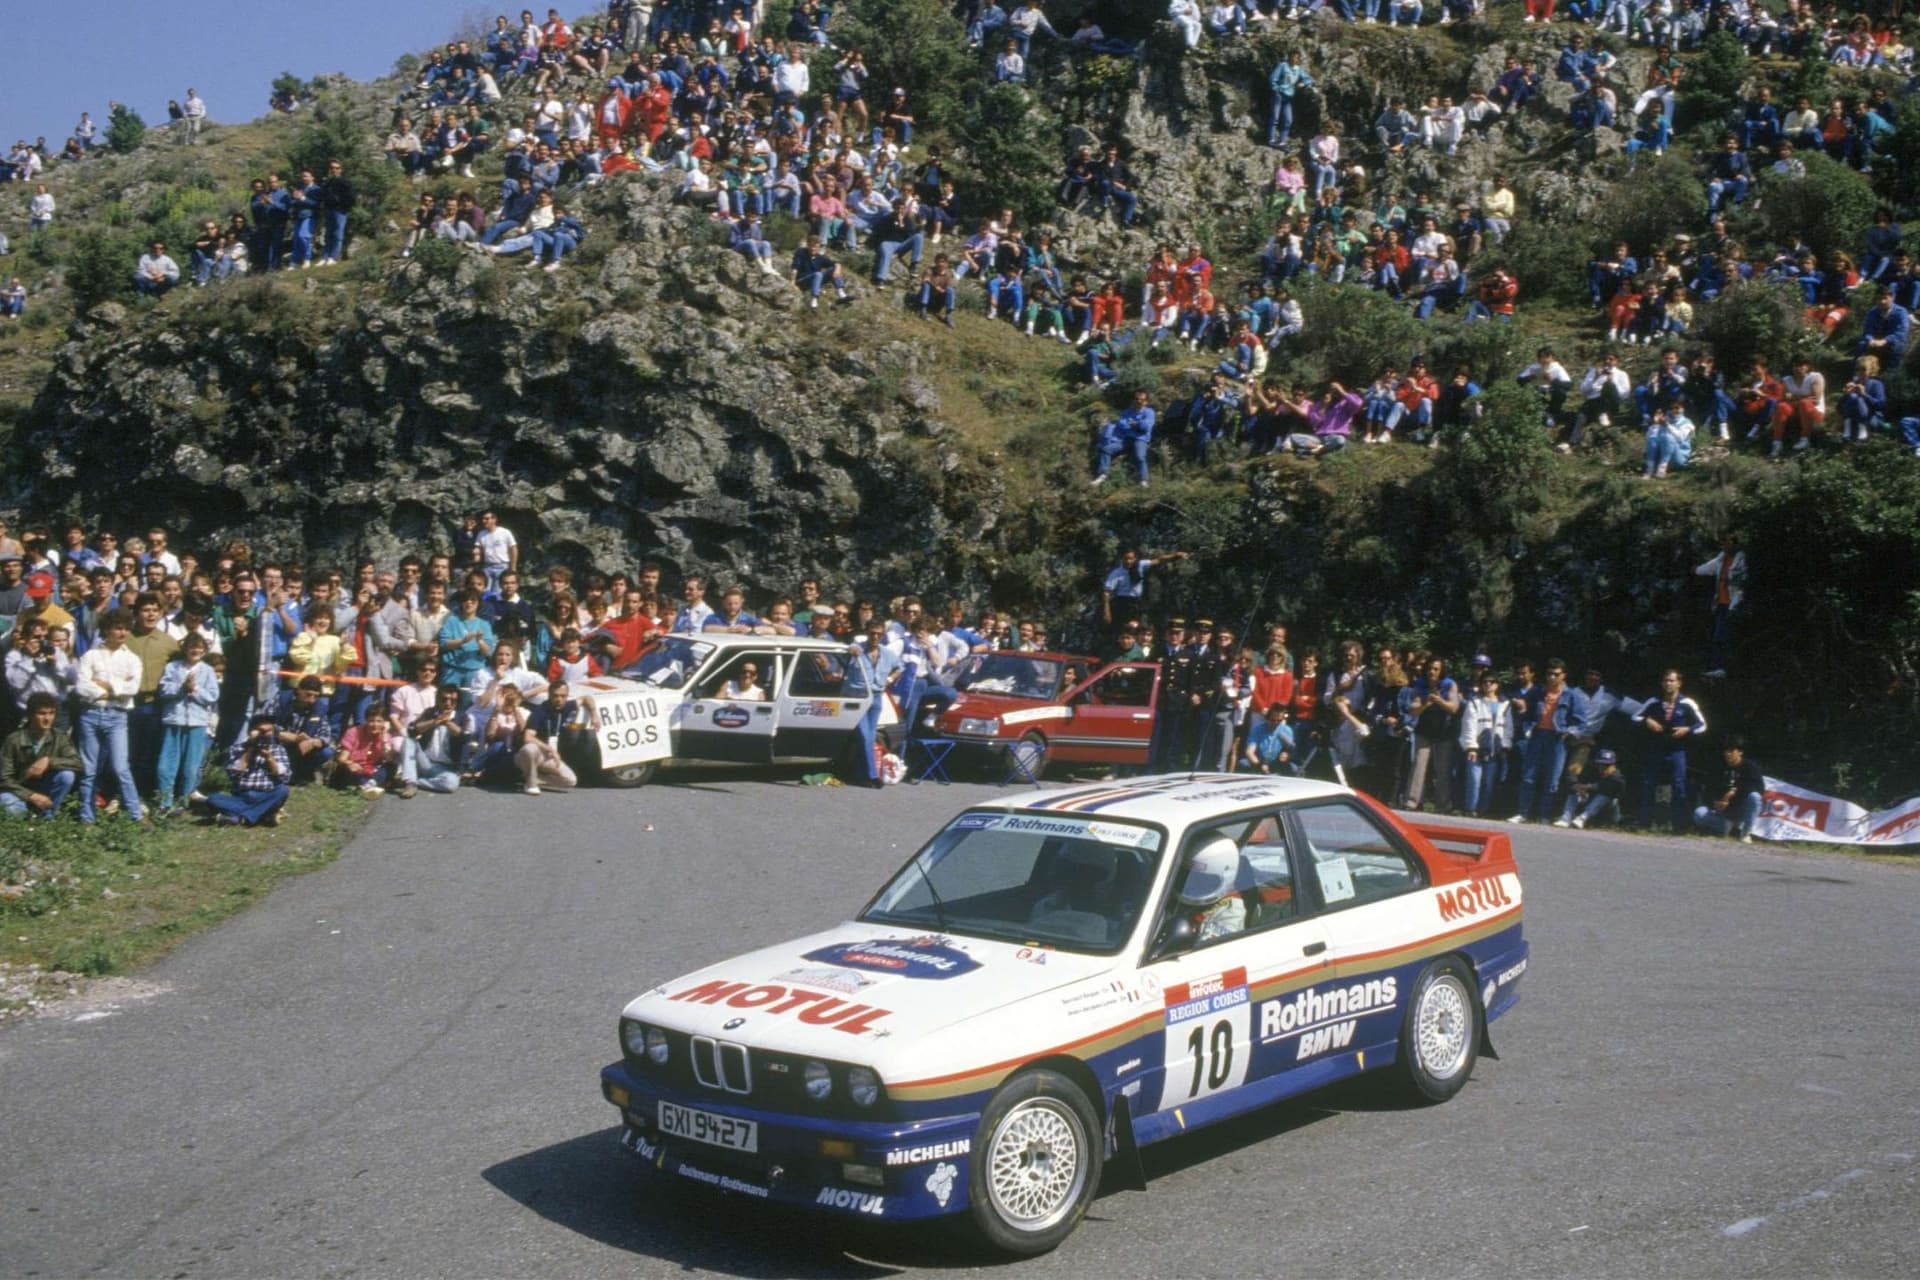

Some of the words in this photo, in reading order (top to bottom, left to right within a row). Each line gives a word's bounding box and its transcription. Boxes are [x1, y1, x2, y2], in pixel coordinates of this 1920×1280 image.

[602, 697, 659, 727] RADIO
[607, 724, 658, 750] S.O.S
[1004, 817, 1085, 835] Rothmans
[1435, 875, 1512, 922] MOTUL
[668, 980, 893, 1035] MOTUL
[1169, 1001, 1210, 1022] REGION
[1213, 988, 1247, 1008] CORSE
[1259, 974, 1397, 1039] Rothmans
[1297, 1020, 1356, 1060] BMW
[1188, 1018, 1233, 1099] 10
[663, 1105, 690, 1135] GXI
[695, 1113, 750, 1148] 9427
[886, 1139, 970, 1166] MICHELIN
[720, 1175, 769, 1198] Rothmans
[816, 1186, 884, 1216] MOTUL
